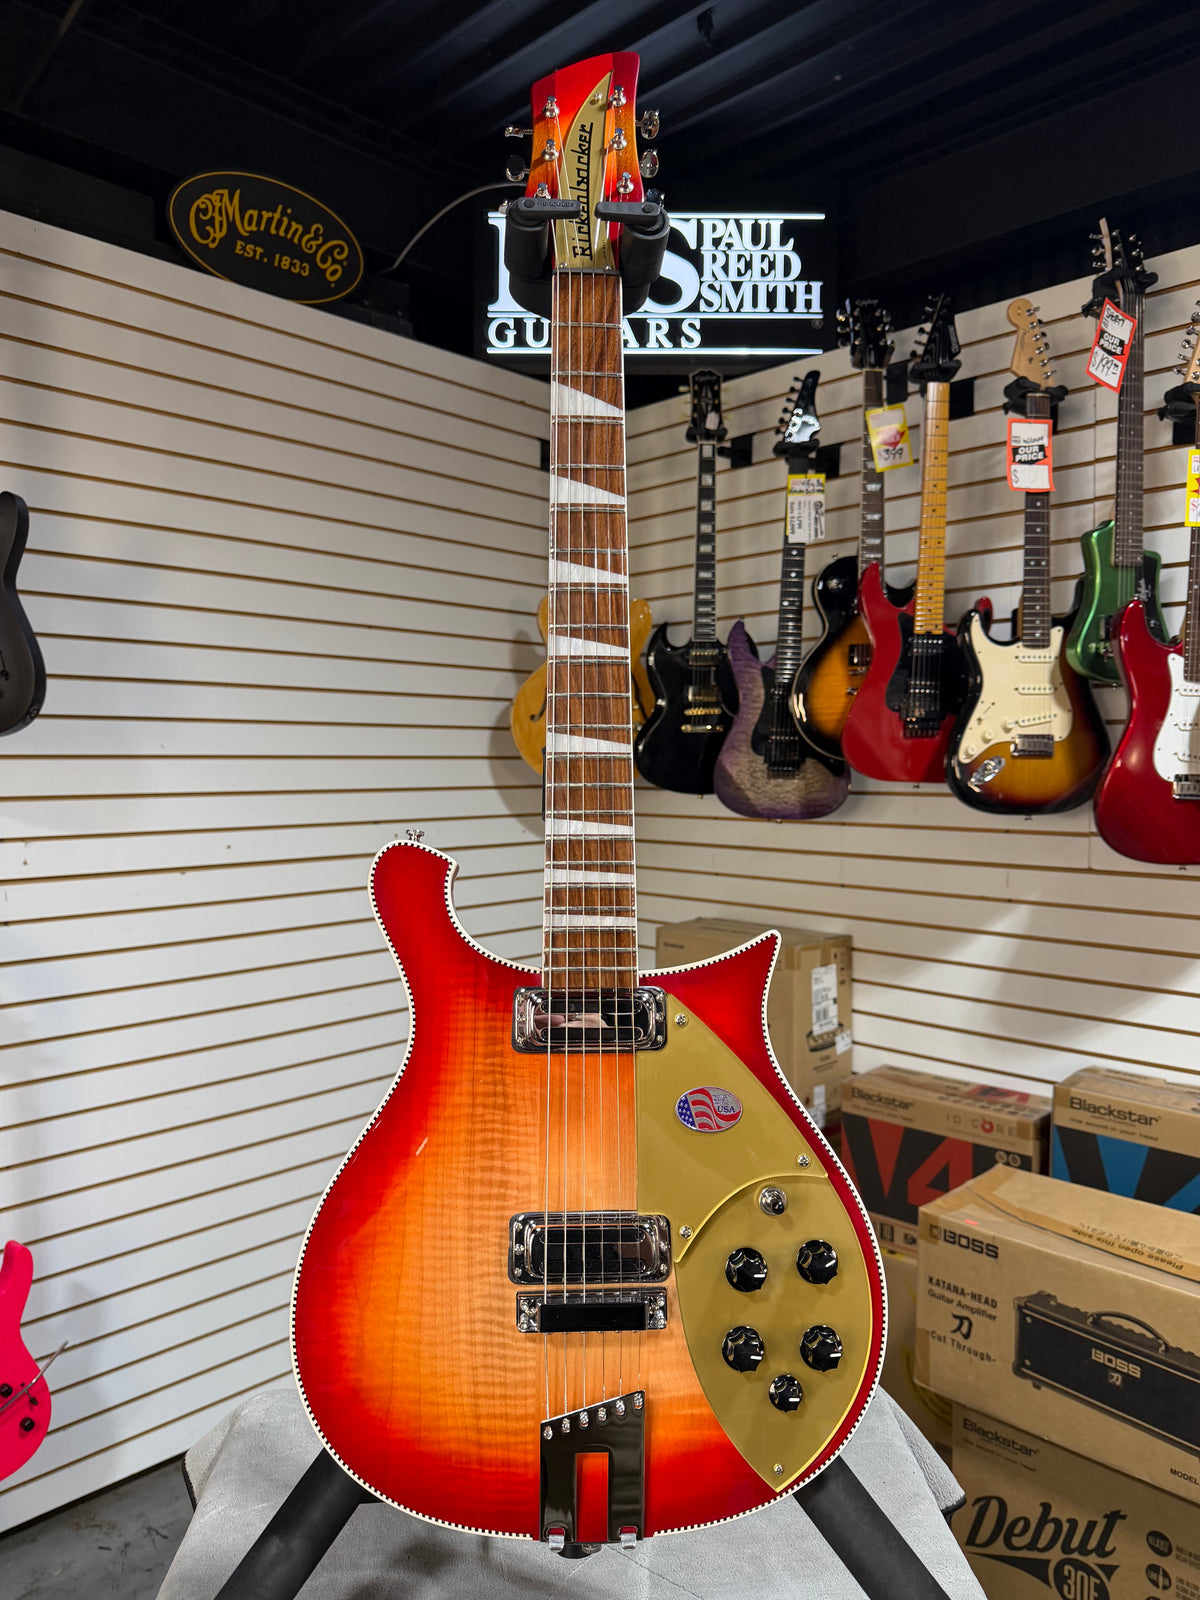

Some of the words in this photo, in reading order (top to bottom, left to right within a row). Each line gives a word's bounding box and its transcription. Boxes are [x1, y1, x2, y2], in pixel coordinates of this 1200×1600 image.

[700, 218, 794, 251] PAUL
[235, 240, 268, 263] EST.
[273, 253, 310, 277] 1833
[700, 249, 802, 282] REED
[699, 280, 824, 313] SMITH
[487, 317, 702, 349] GUARS
[1099, 339, 1123, 355] PRICE
[1103, 332, 1121, 346] OUR
[1015, 452, 1045, 463] PRICE
[1018, 445, 1040, 455] OUR
[717, 1105, 736, 1114] USA
[851, 1086, 913, 1110] Blackstar
[1069, 1096, 1159, 1127] Blackstar
[942, 1228, 999, 1260] BOSS
[1096, 1236, 1115, 1248] this
[1118, 1243, 1145, 1256] open
[1147, 1253, 1184, 1271] Please
[927, 1274, 998, 1309] KATANA-HEAD
[927, 1288, 954, 1305] Guitar
[955, 1300, 998, 1322] Amplifier
[1091, 1347, 1142, 1380] BOSS
[962, 1417, 1036, 1458] Blackstar
[1169, 1467, 1200, 1486] MODEL
[964, 1495, 1128, 1559] Debut
